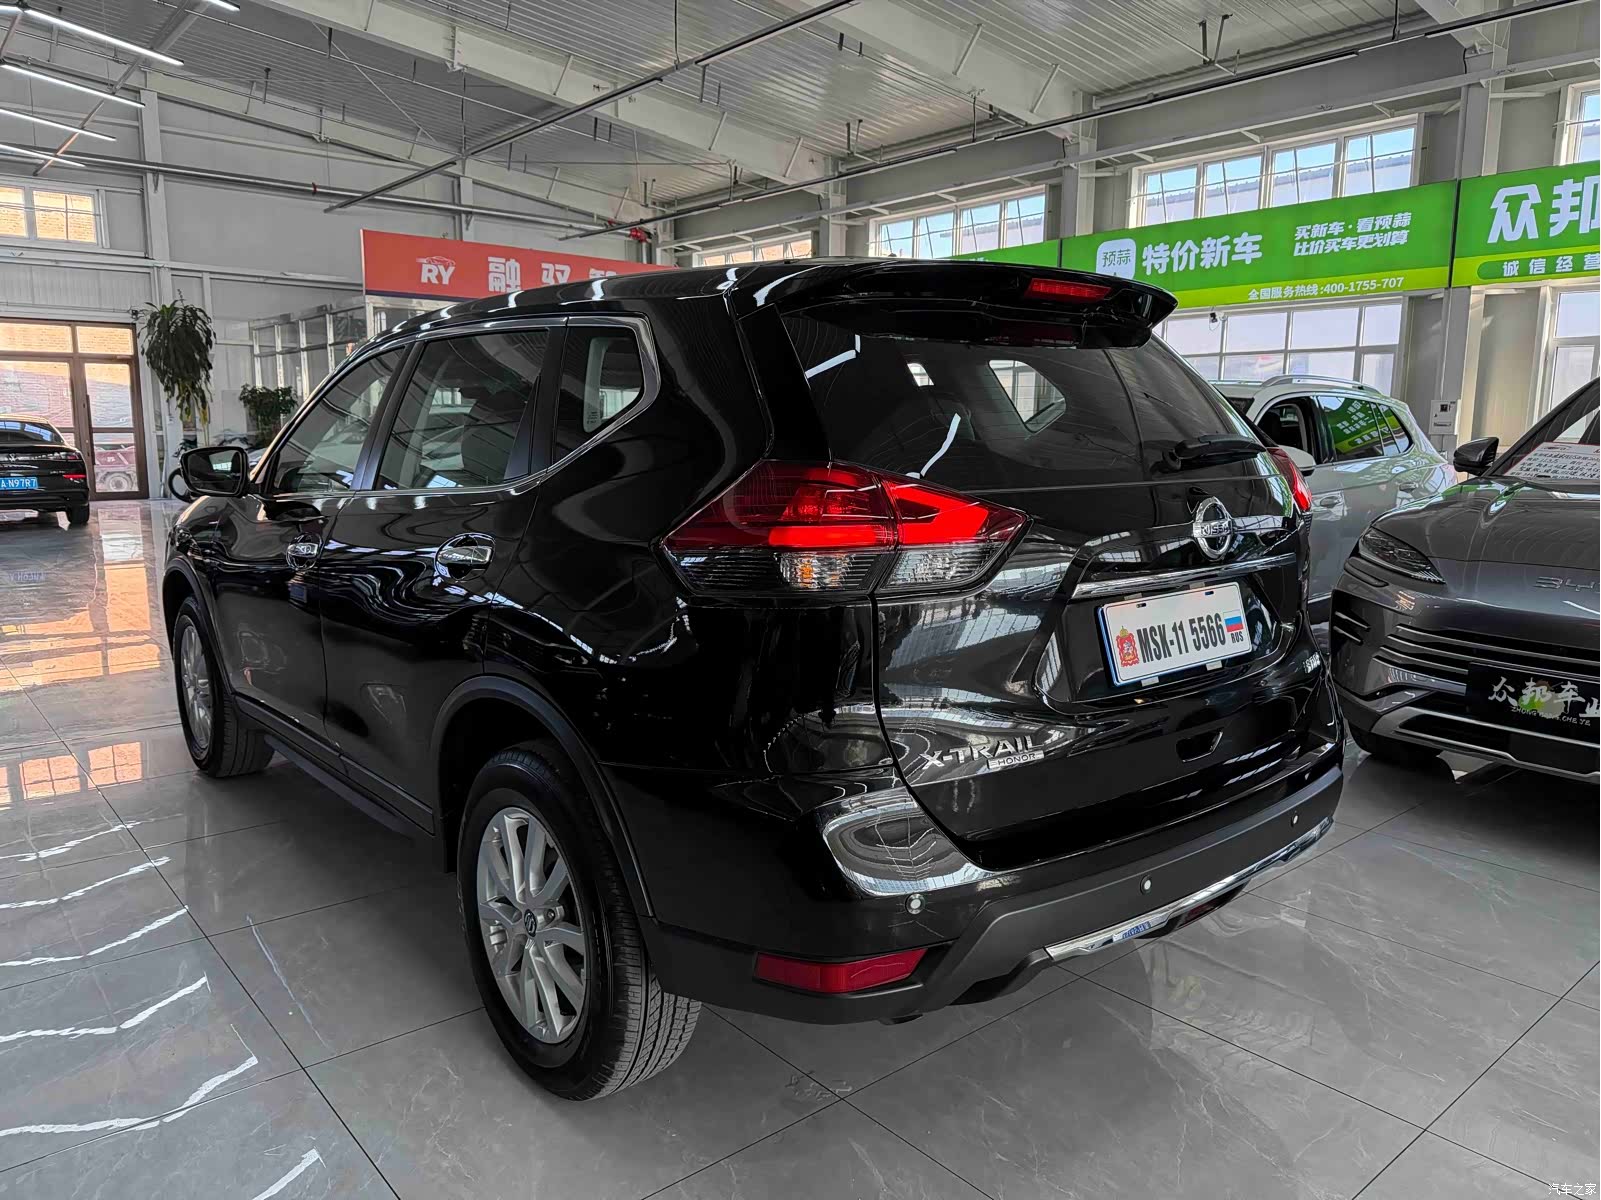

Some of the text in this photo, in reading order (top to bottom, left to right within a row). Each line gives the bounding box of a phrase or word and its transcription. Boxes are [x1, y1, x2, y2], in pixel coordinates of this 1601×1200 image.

[1487, 175, 1600, 244] 众邦
[1142, 232, 1263, 275] 特价新车
[1293, 230, 1410, 256] 比价买车更划算
[1102, 249, 1131, 267] 预蒜
[1503, 253, 1600, 277] 诚信经营
[421, 264, 455, 285] RY
[1136, 612, 1226, 663] MSK-11 5566
[1230, 631, 1244, 644] RUS
[919, 735, 1034, 770] X-TRAIL
[997, 753, 1036, 766] HONOR
